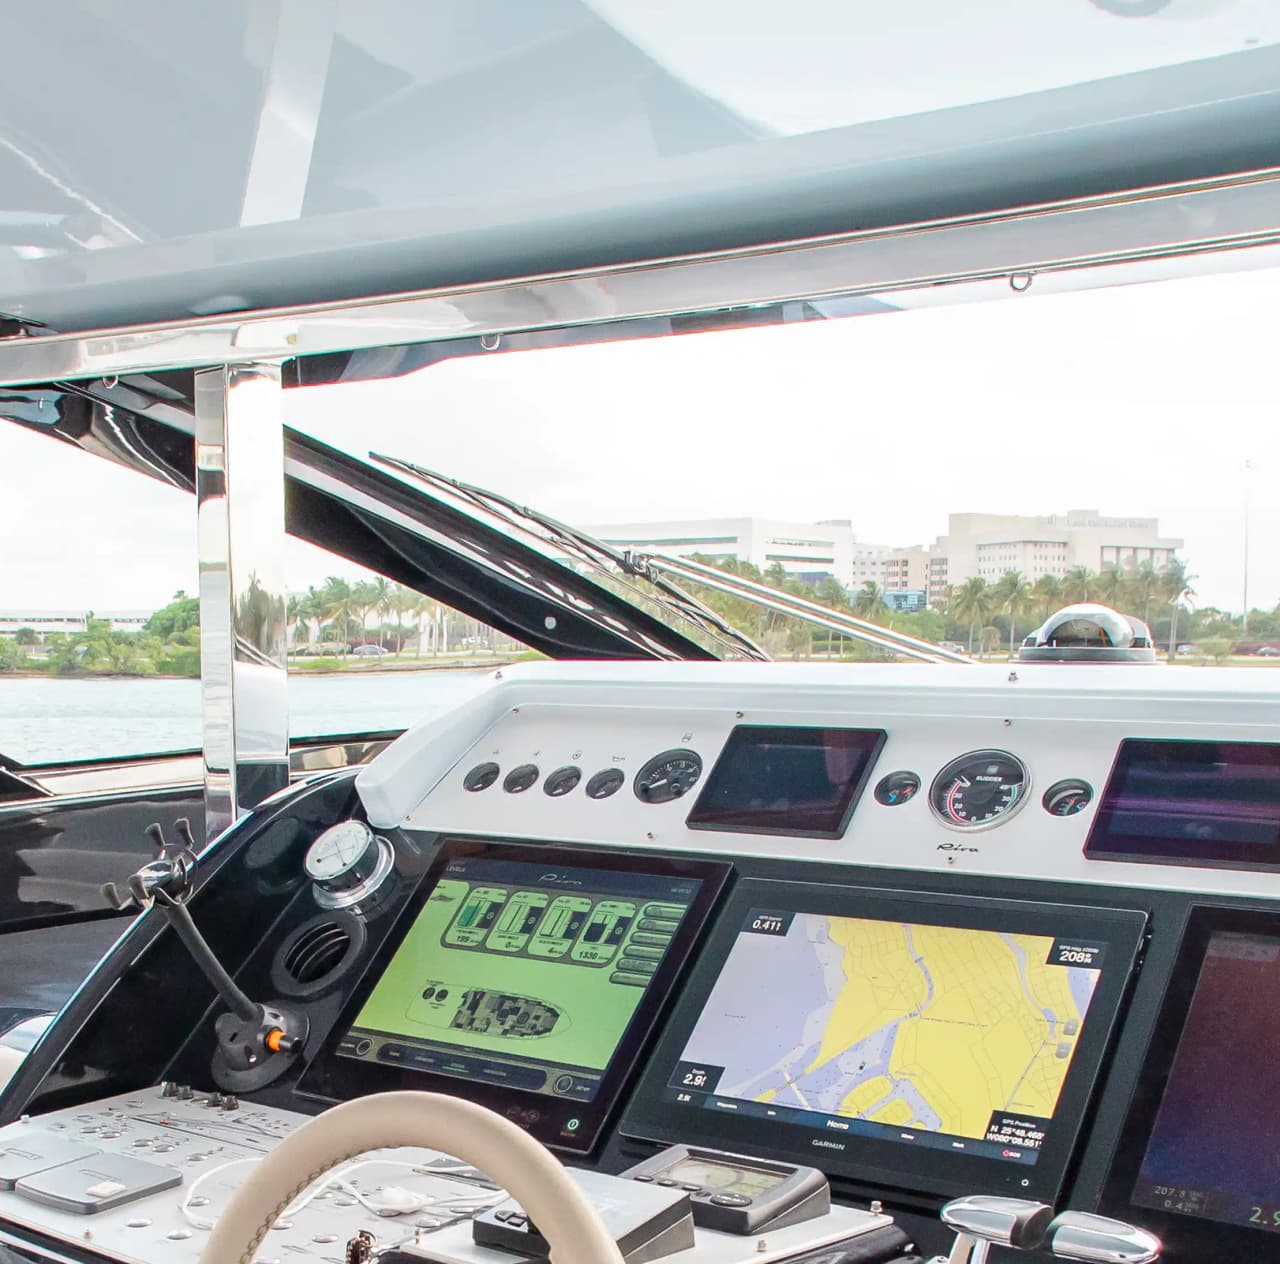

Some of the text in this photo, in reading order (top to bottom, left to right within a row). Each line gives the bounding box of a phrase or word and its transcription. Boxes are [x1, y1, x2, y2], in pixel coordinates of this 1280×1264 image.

[975, 775, 1003, 783] RUDDER
[936, 843, 979, 854] Riva
[826, 1119, 850, 1130] Home
[811, 1138, 846, 1151] GARMIN
